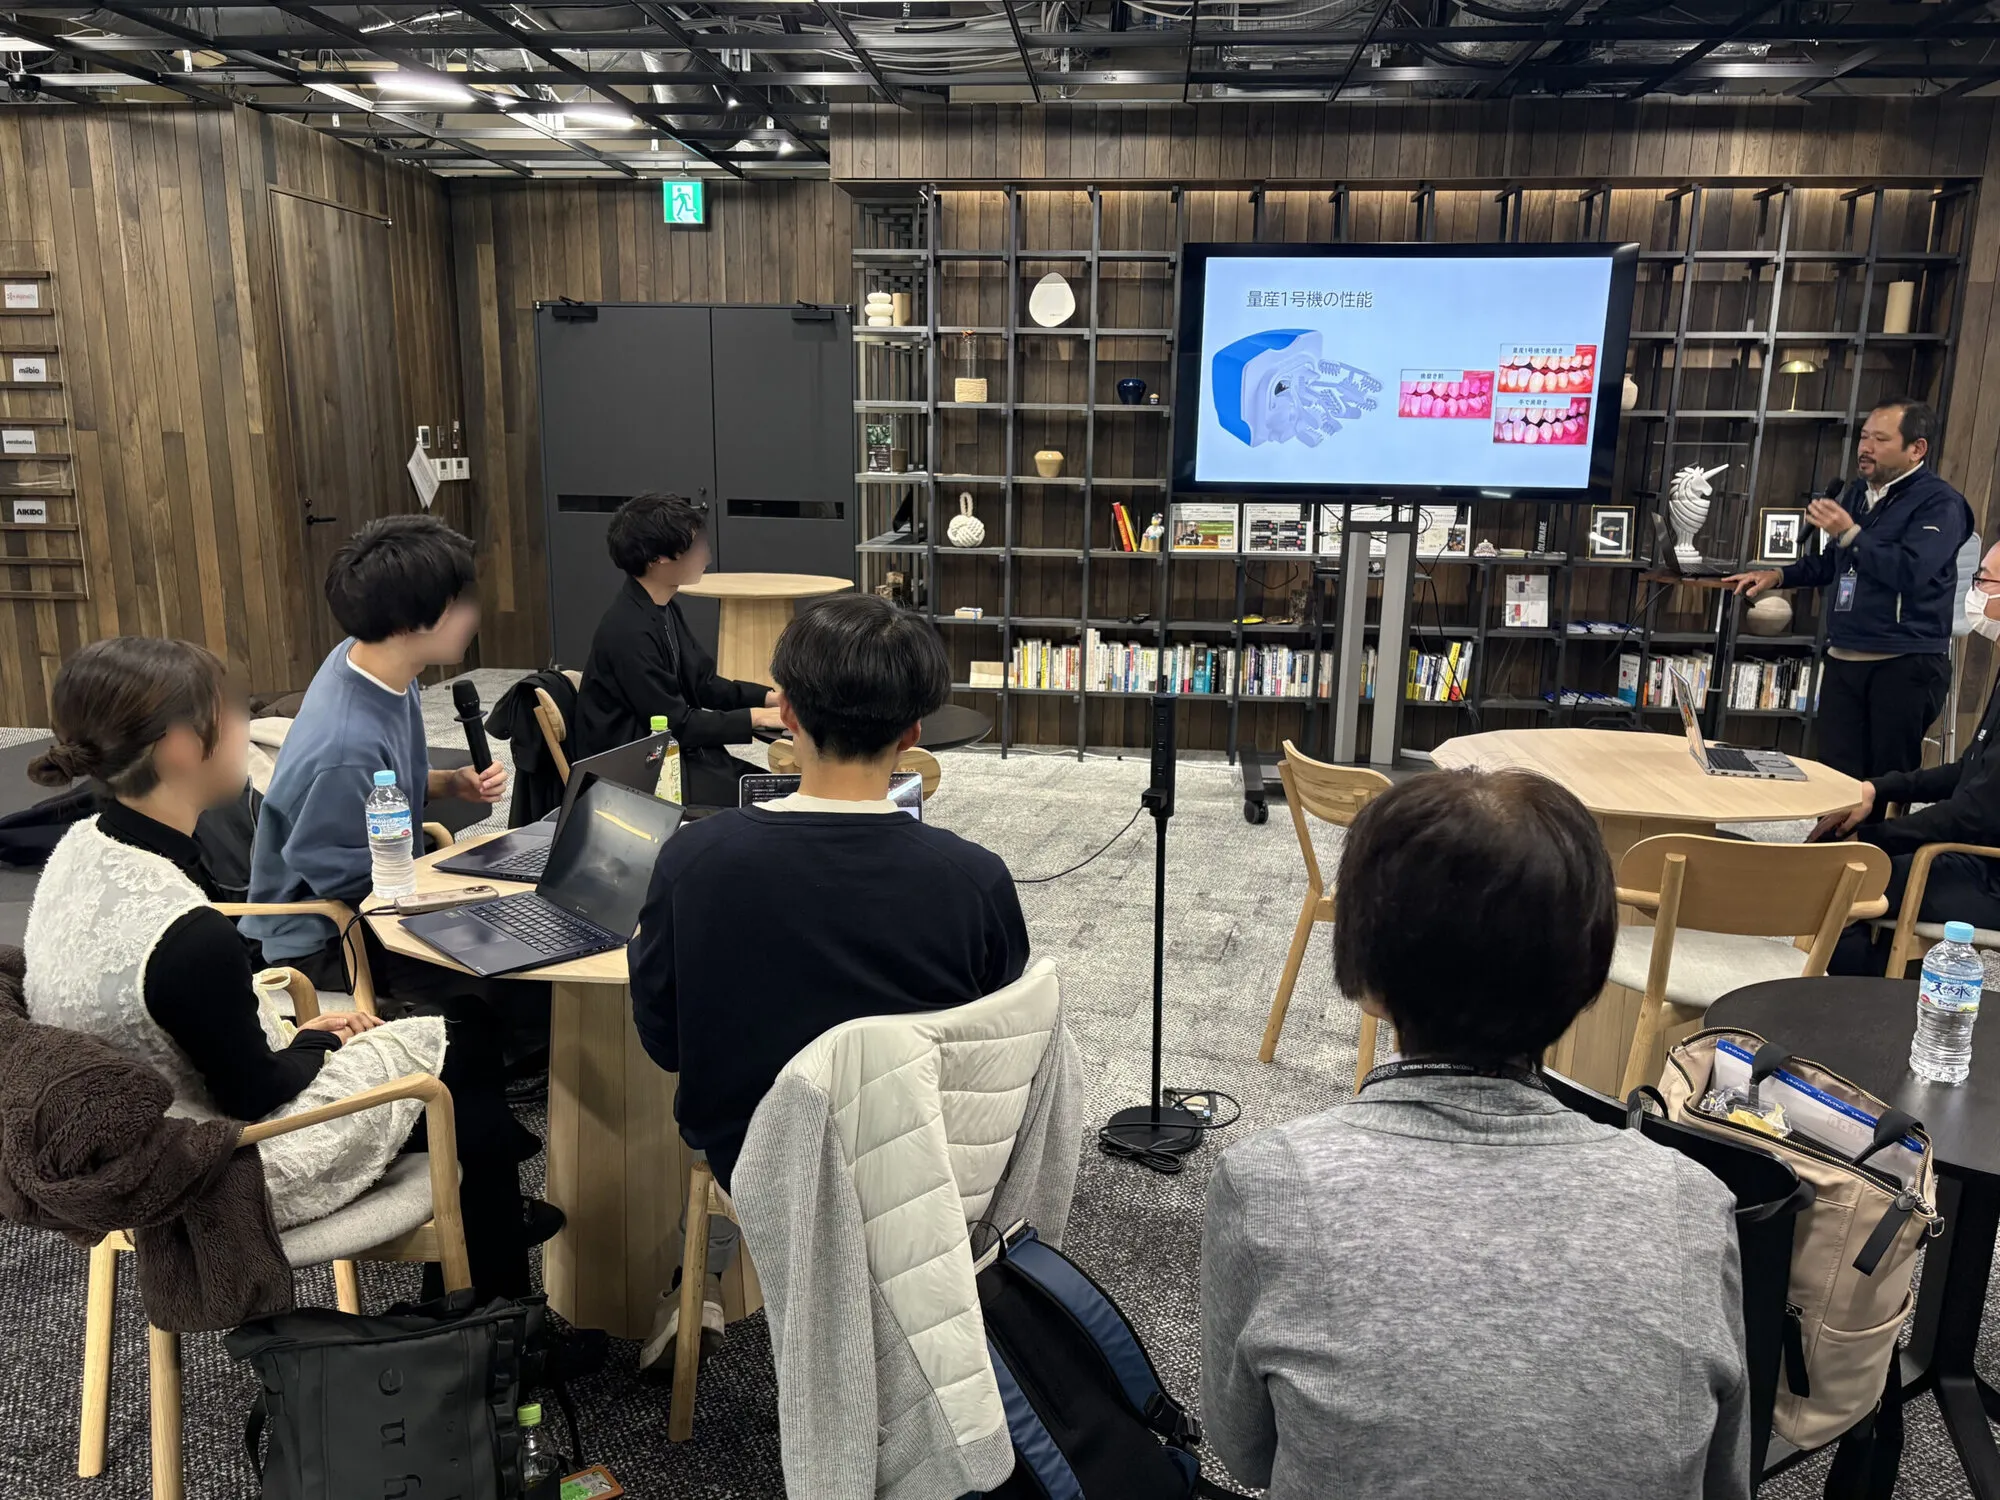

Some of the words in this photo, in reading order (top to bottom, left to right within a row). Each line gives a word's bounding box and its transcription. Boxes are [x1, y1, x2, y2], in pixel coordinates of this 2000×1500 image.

[1246, 290, 1373, 309] 量産1号機の性能
[16, 508, 43, 516] AIKIDO
[1537, 520, 1548, 553] OLIWARE
[1930, 981, 1970, 999] 天然水
